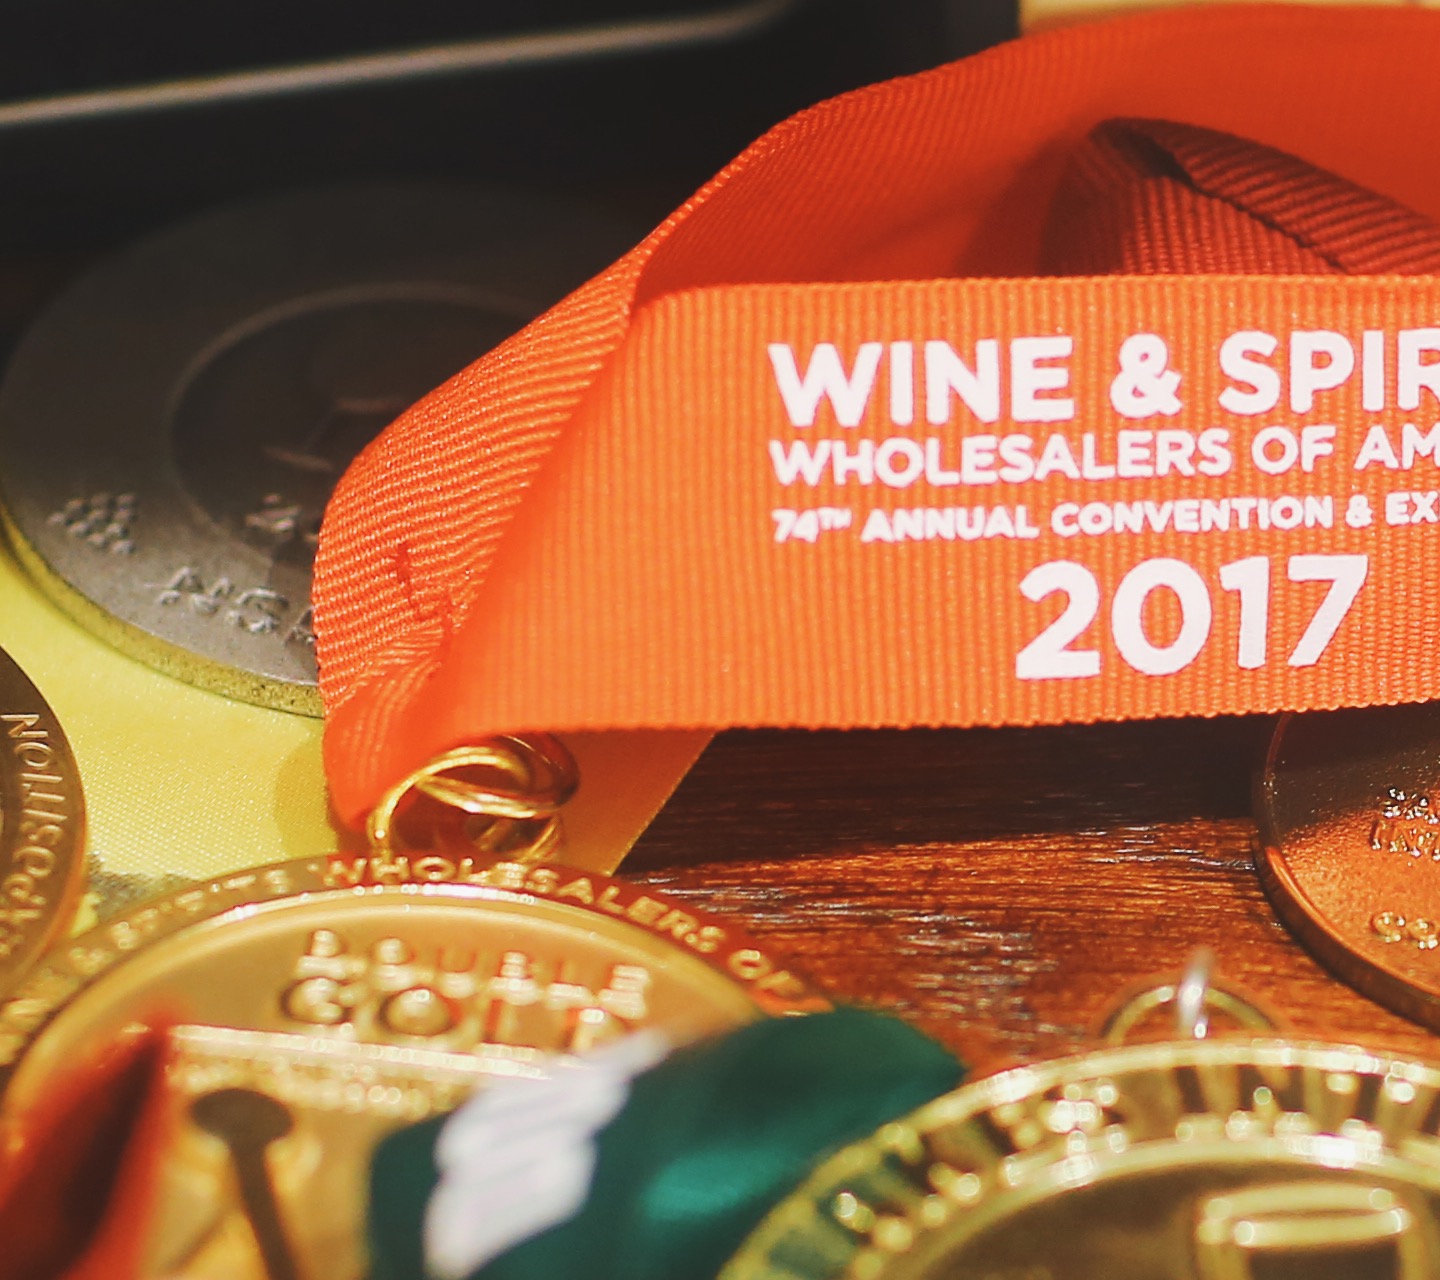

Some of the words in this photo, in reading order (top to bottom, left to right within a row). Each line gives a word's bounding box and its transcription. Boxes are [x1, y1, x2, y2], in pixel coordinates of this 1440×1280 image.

[766, 334, 1077, 429] WINE
[1108, 331, 1186, 420] &
[768, 426, 1235, 490] WHOLESALERS
[1250, 422, 1338, 476] OF
[770, 505, 854, 544] 74TH
[859, 503, 1042, 544] ANNUAL
[1049, 493, 1335, 539] CONVENTION
[1344, 493, 1375, 530] &
[1014, 552, 1370, 682] 2017
